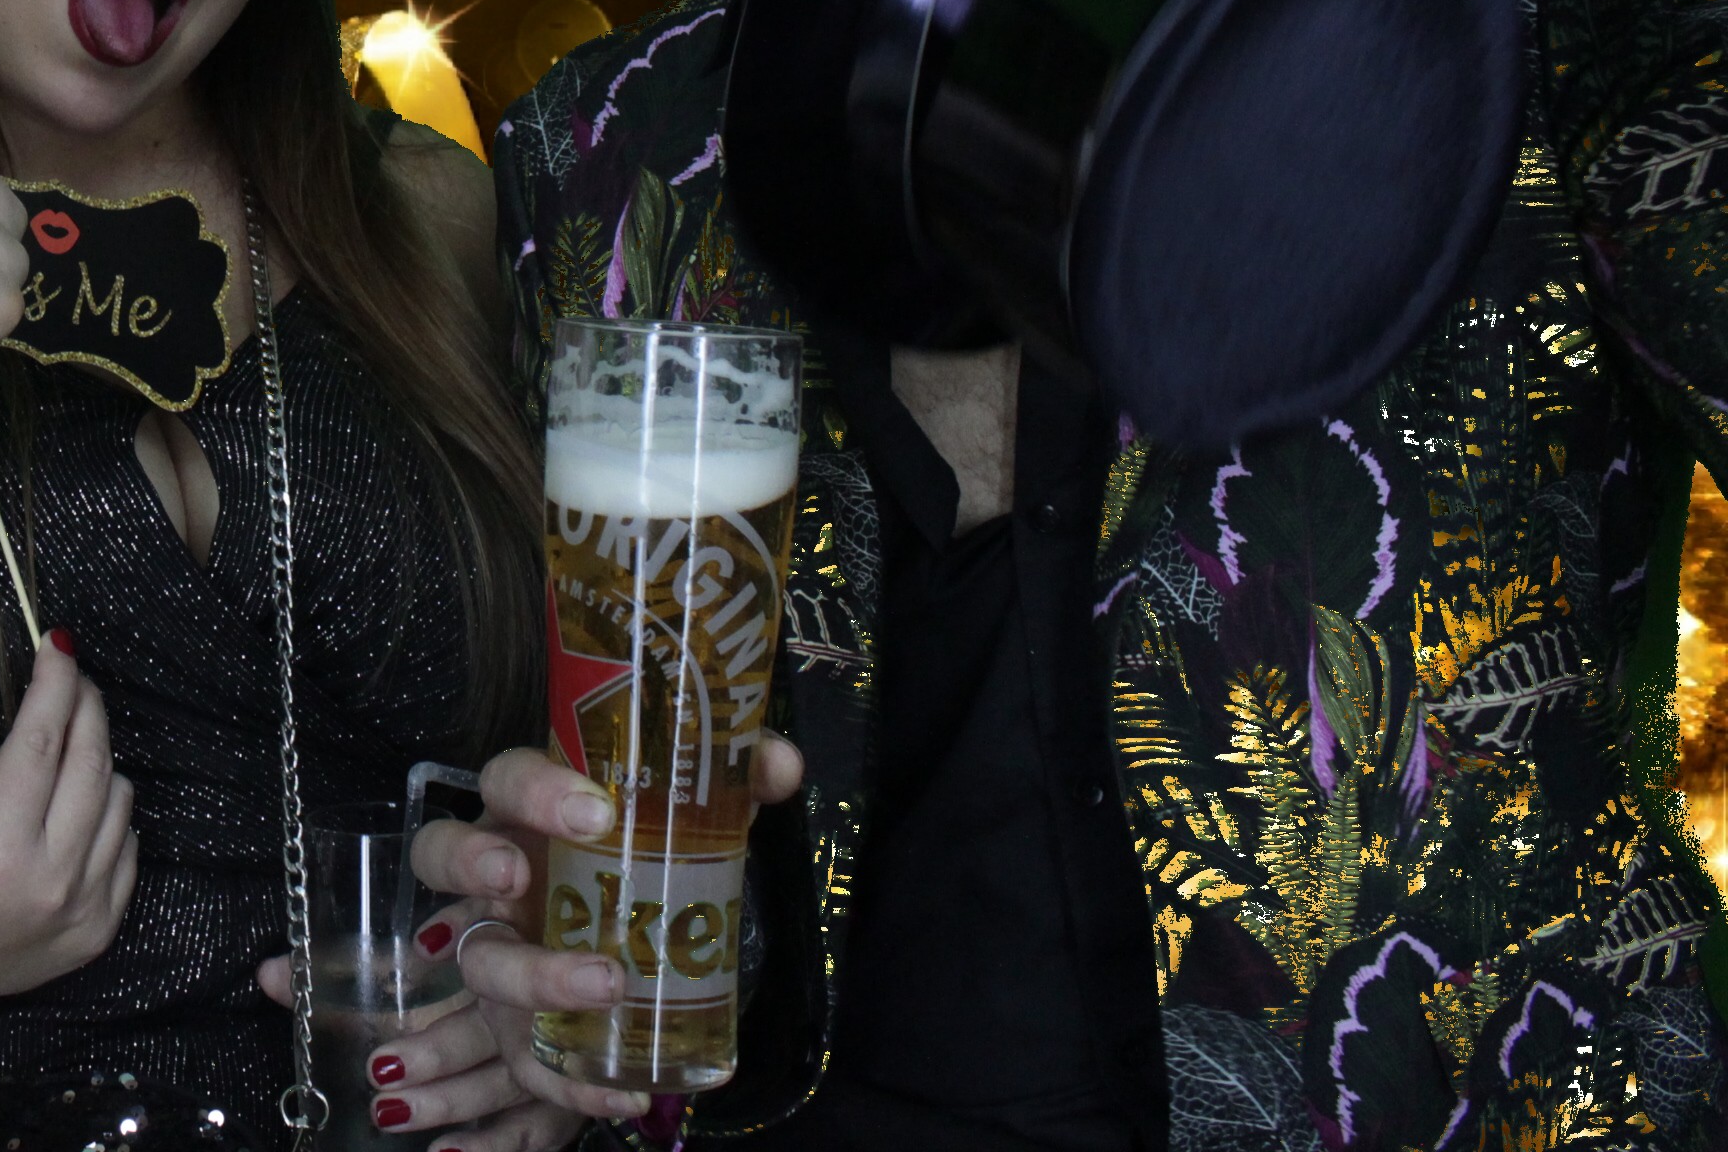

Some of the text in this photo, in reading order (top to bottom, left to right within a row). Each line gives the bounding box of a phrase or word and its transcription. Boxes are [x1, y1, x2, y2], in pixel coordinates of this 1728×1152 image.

[72, 261, 172, 338] Me
[558, 503, 767, 766] ORIGINAL
[603, 760, 652, 789] 183
